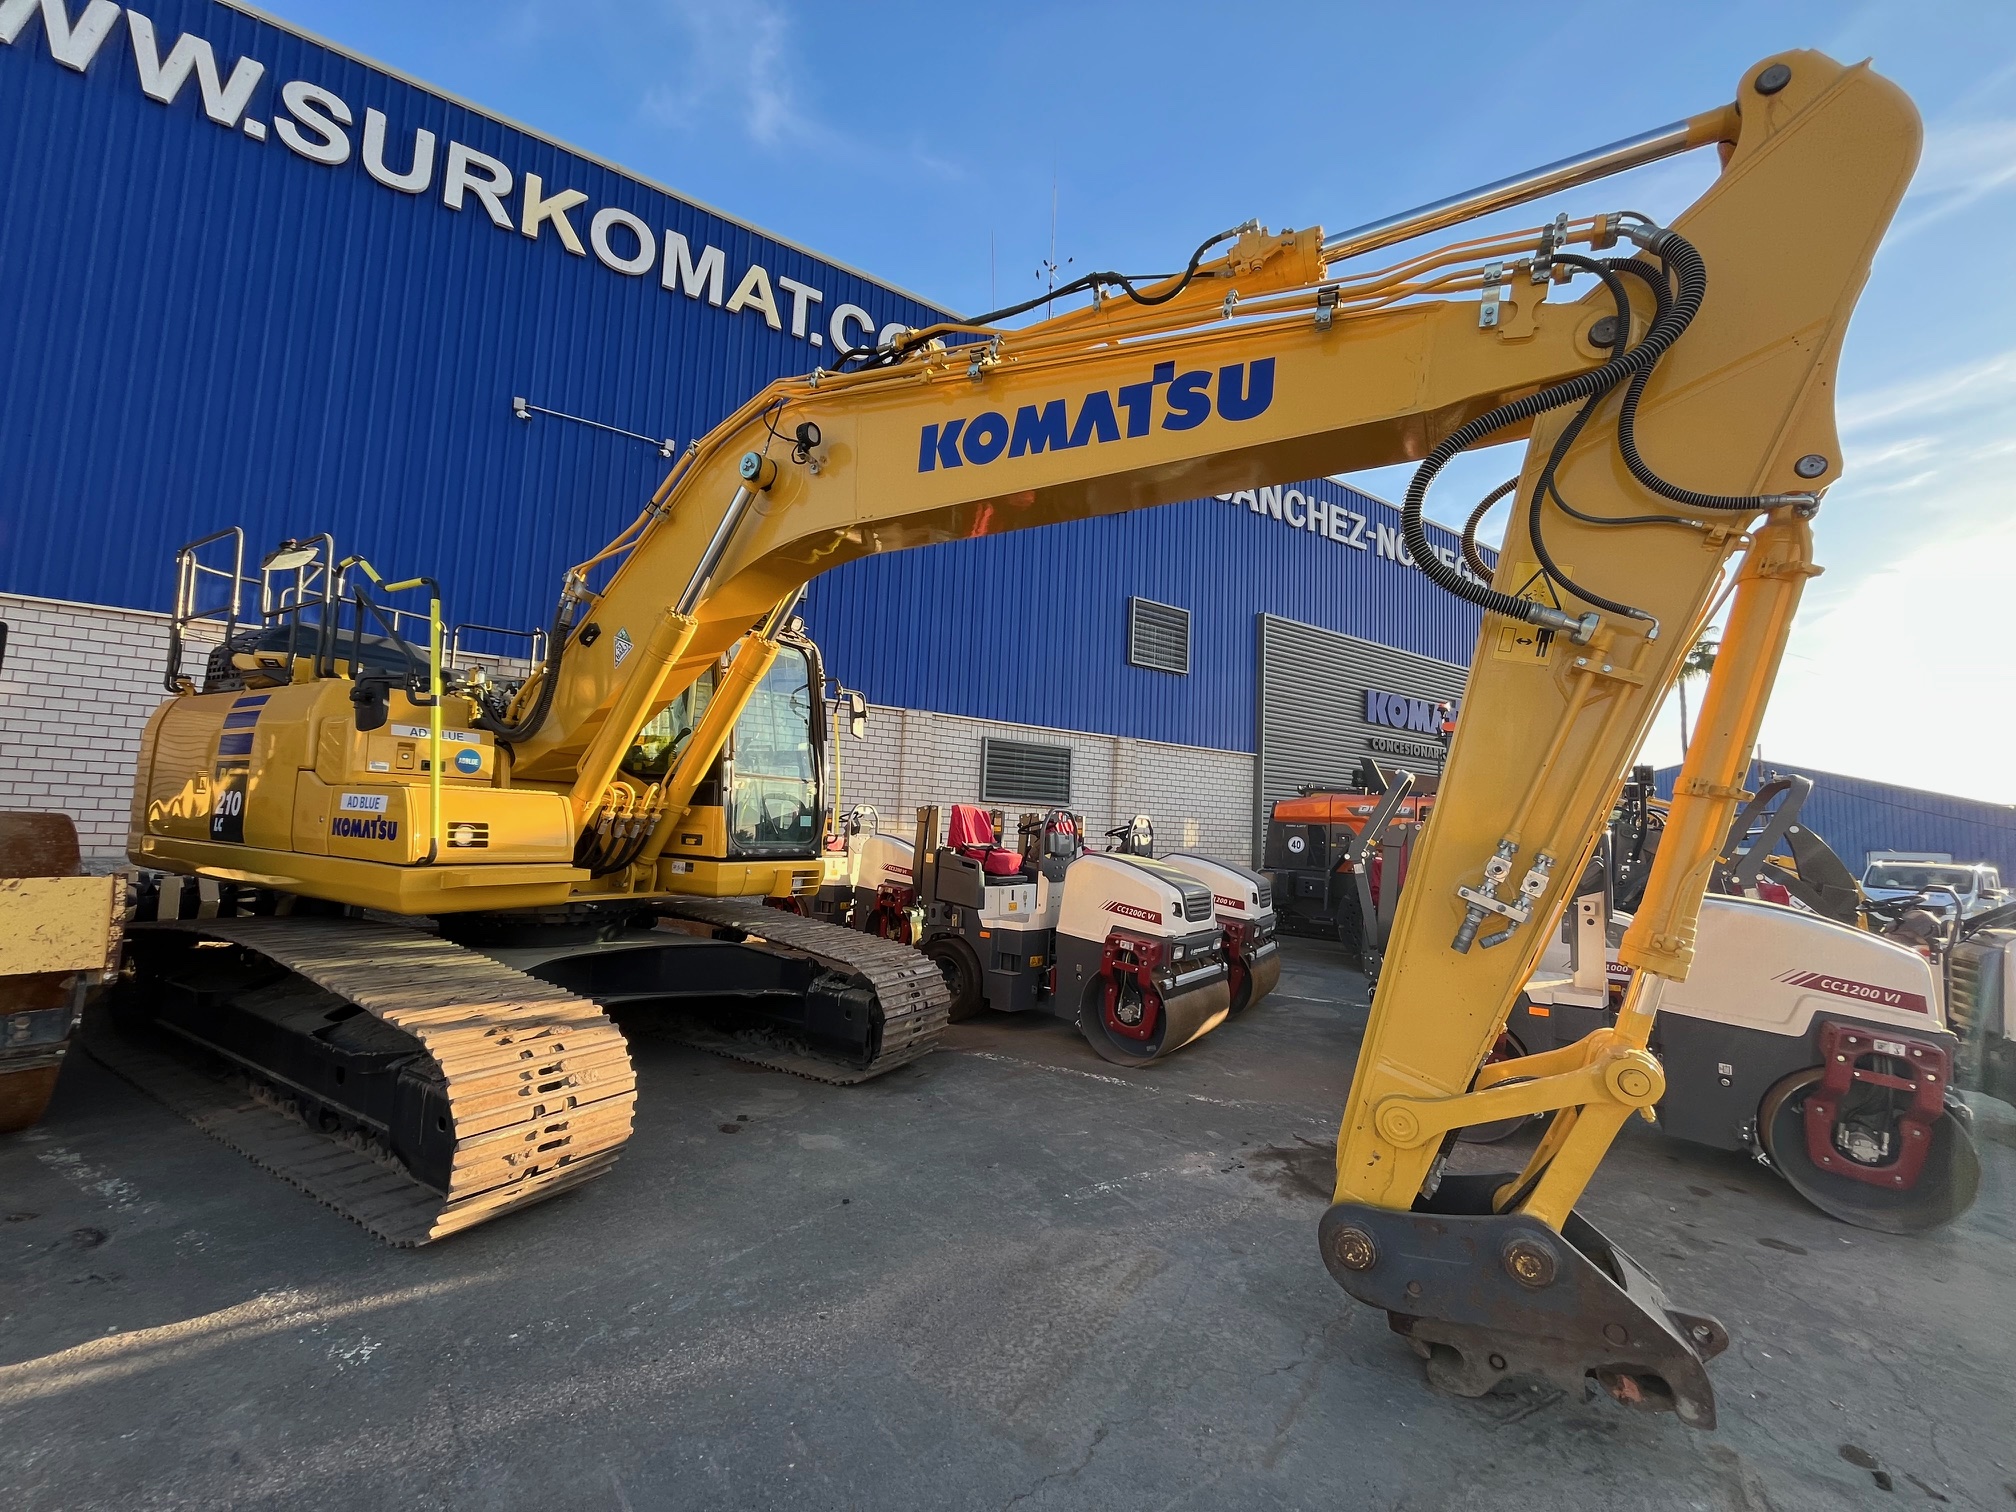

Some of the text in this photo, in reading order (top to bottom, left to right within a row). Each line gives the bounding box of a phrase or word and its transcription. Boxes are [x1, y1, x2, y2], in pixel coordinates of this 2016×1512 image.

[918, 357, 1276, 473] KOMATSU
[410, 727, 464, 742] AD LUE
[214, 790, 242, 816] 210
[347, 796, 381, 810] AD BLUE
[213, 817, 224, 832] LC
[331, 815, 398, 841] KOMATSU
[1291, 840, 1302, 850] 40
[1116, 905, 1156, 921] CC1200C VI
[1820, 979, 1902, 1004] CC1200 VI
